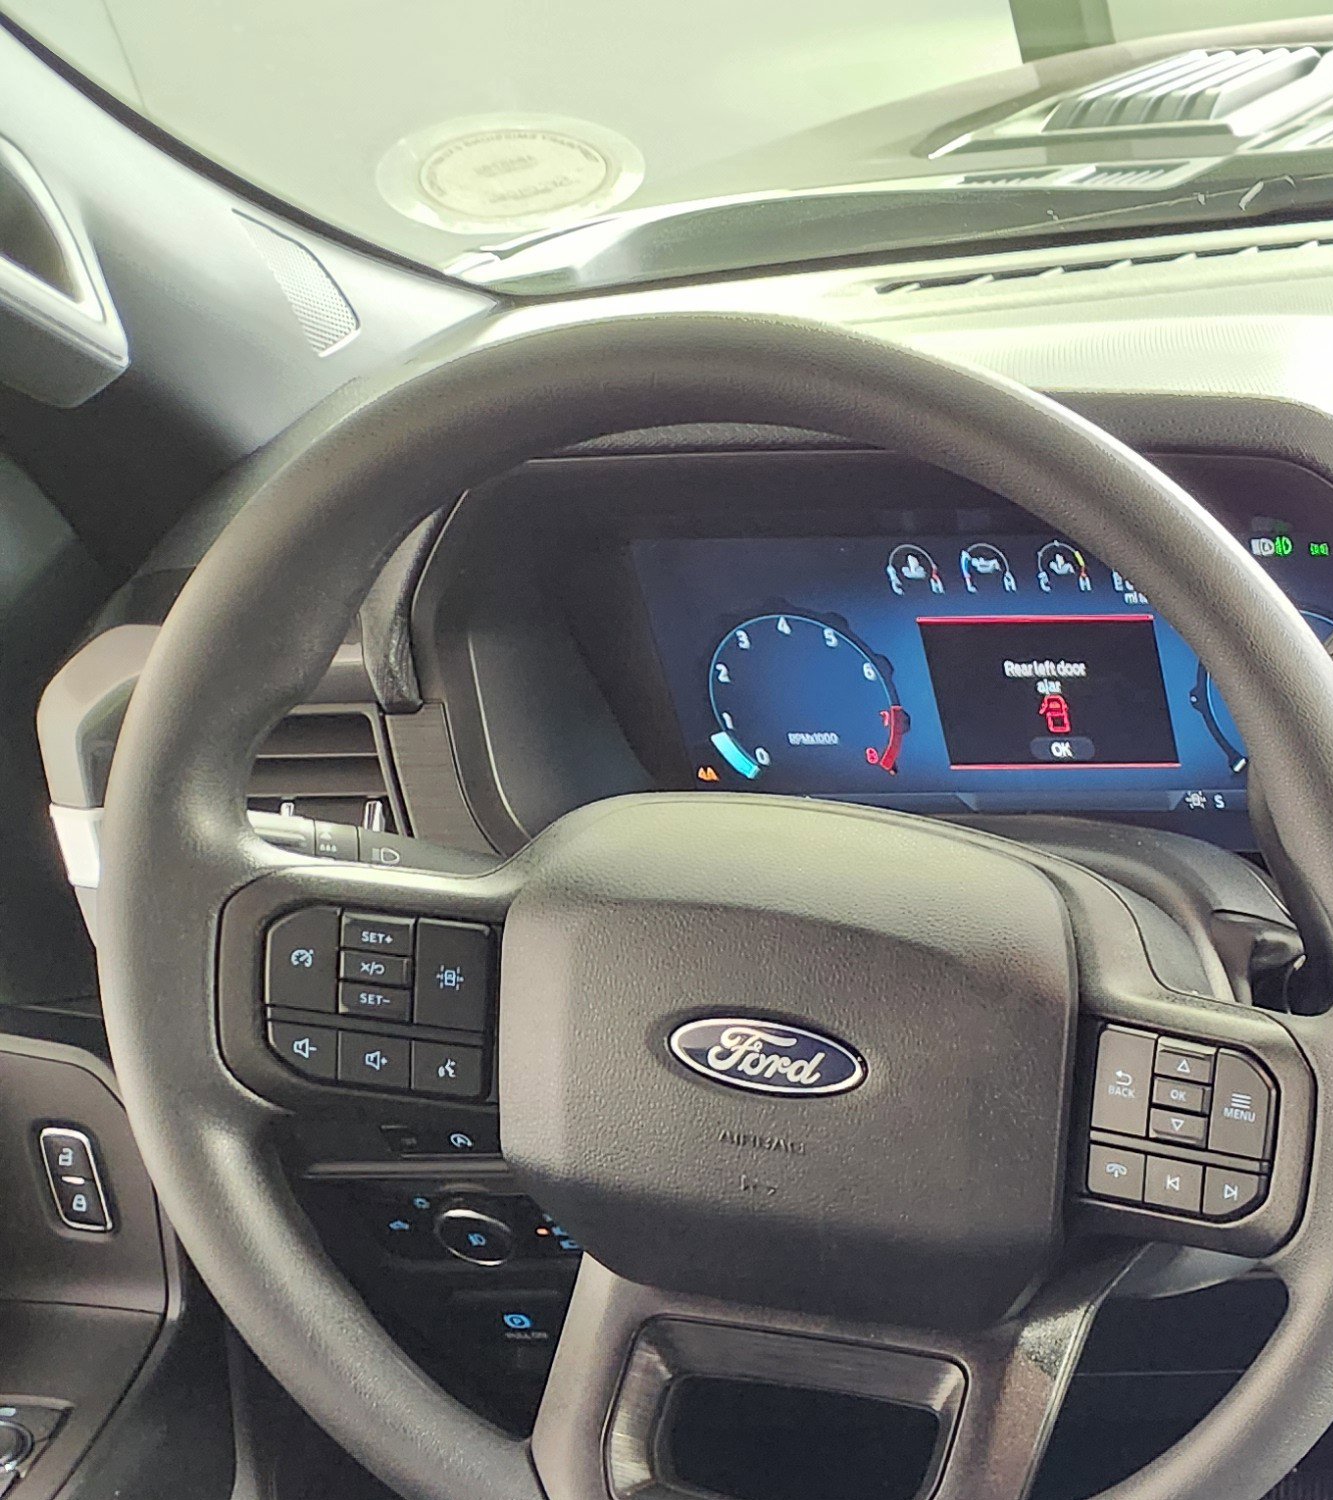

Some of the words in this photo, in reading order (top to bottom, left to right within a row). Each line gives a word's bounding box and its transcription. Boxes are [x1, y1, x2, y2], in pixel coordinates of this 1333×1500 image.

[776, 616, 791, 635] 4
[735, 629, 750, 649] 3
[823, 627, 838, 648] 5
[716, 663, 731, 683] 2
[863, 661, 877, 681] 6
[1003, 660, 1034, 677] Rear
[1034, 658, 1057, 677] left
[1058, 660, 1086, 677] door
[1037, 679, 1062, 695] ajar
[721, 712, 734, 730] 1
[879, 710, 889, 727] 7
[755, 747, 770, 766] 0
[1051, 742, 1073, 757] OK
[1214, 794, 1226, 809] S
[361, 930, 393, 944] SET+
[707, 1026, 826, 1085] Ford
[1108, 1085, 1136, 1099] BACK
[1170, 1089, 1186, 1101] OK
[1223, 1107, 1256, 1123] MENU
